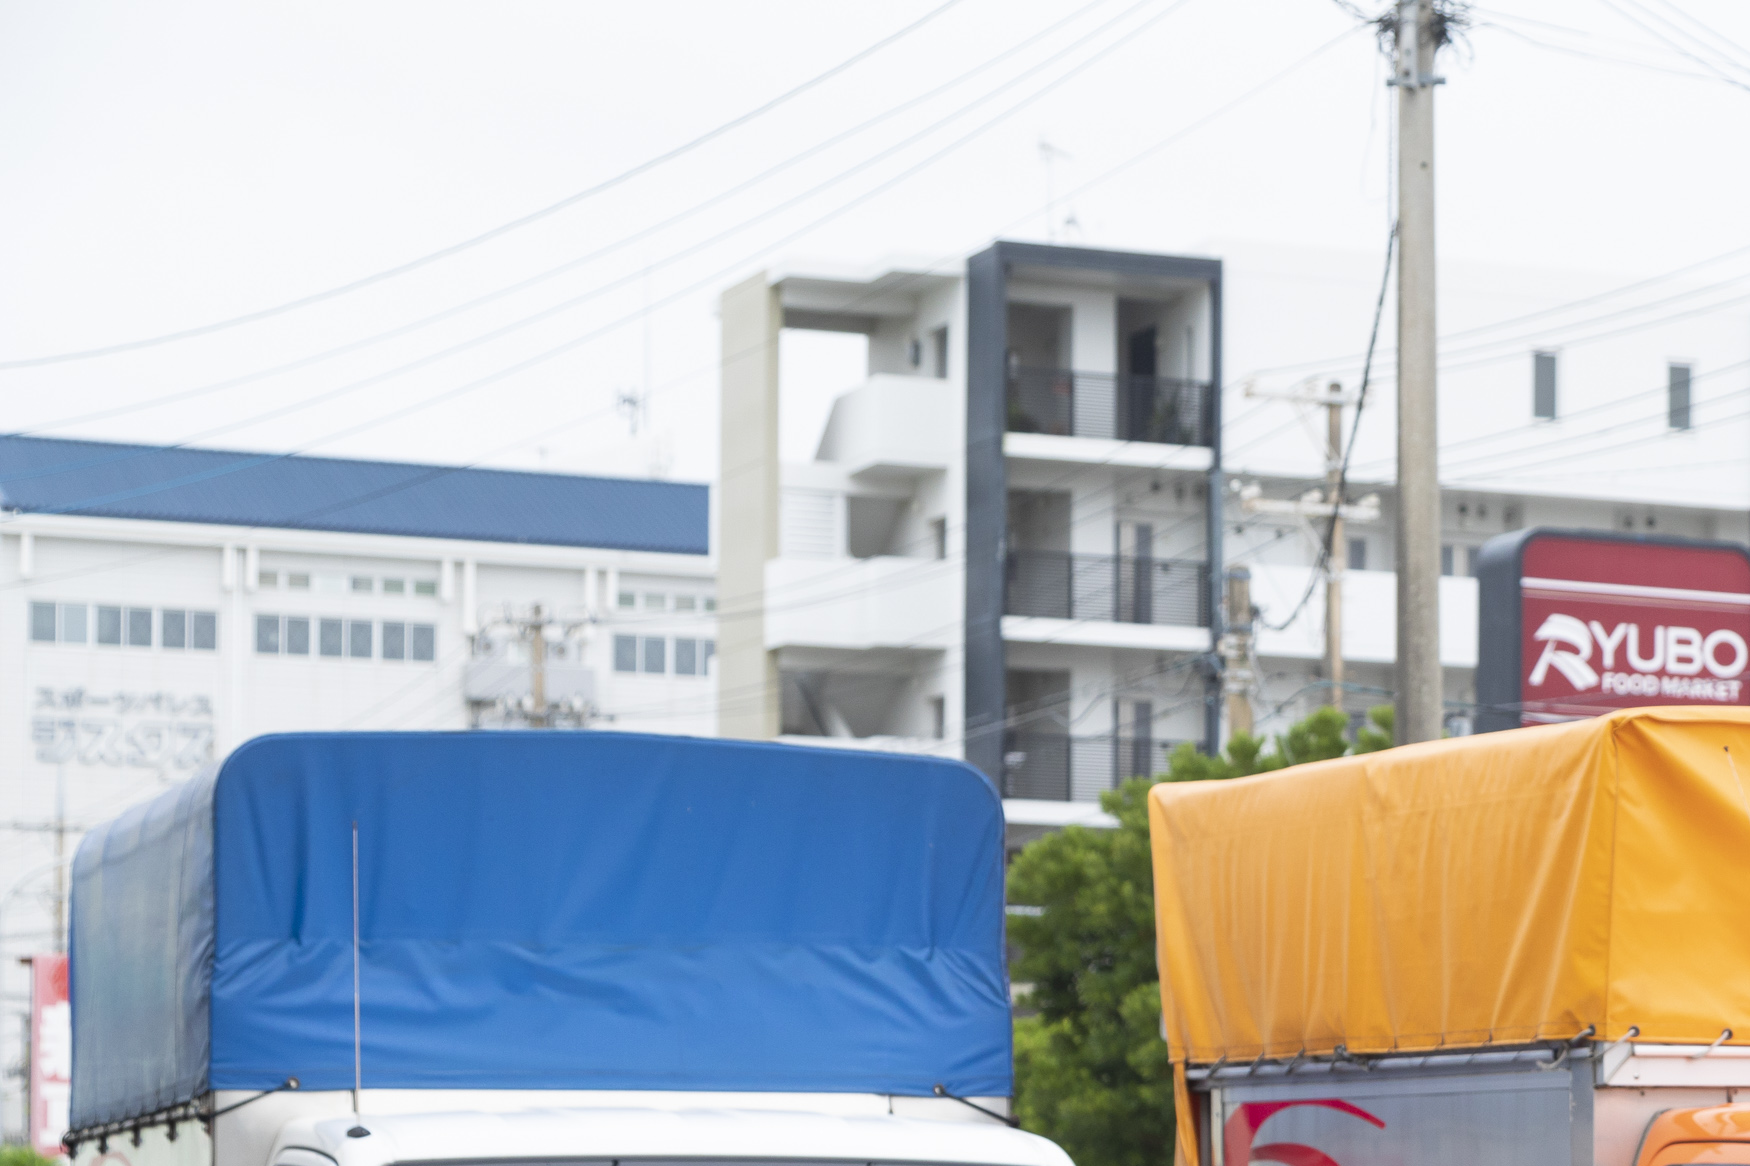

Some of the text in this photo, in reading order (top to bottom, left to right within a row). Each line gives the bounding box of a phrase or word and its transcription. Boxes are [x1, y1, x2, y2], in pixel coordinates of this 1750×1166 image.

[1528, 612, 1749, 691] RYUBO
[1601, 671, 1743, 702] FOOD MARKET
